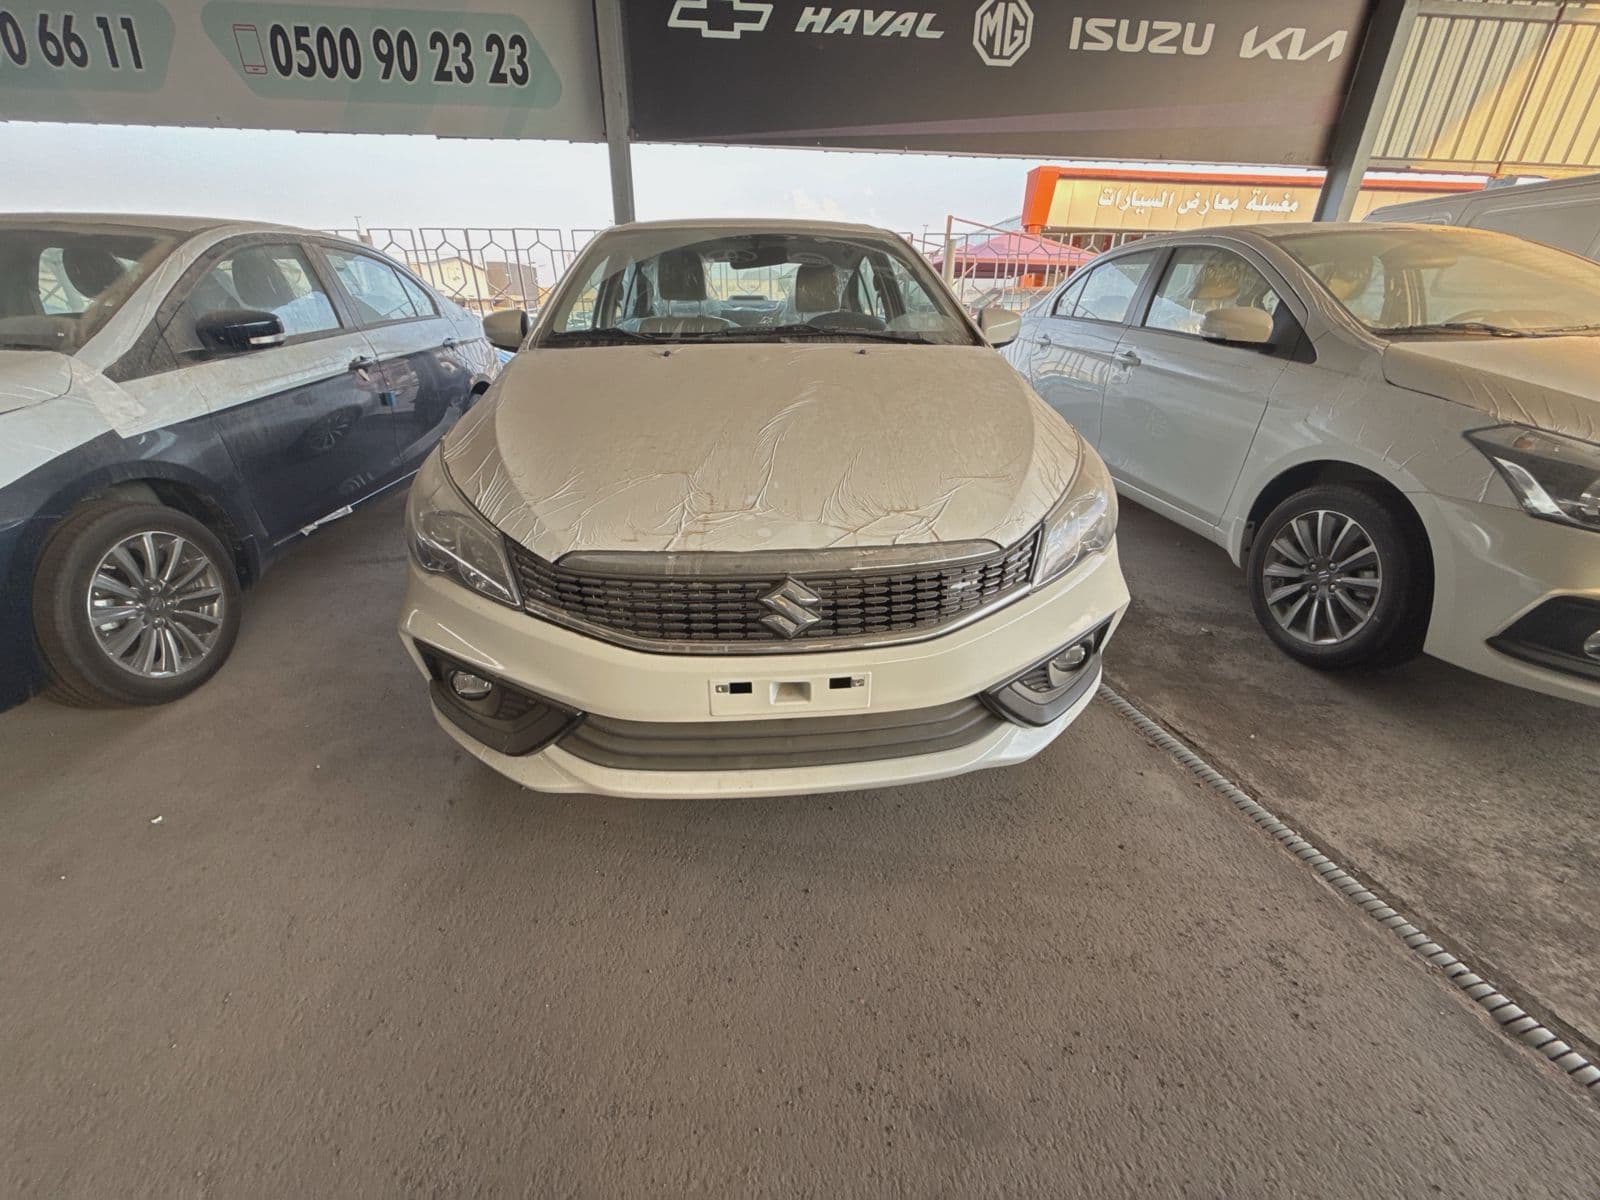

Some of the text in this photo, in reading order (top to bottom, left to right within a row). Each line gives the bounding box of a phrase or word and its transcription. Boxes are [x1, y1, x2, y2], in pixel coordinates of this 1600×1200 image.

[38, 13, 89, 68] 66
[95, 16, 143, 70] 11
[795, 6, 945, 39] HAVAL
[979, 1, 1027, 57] MG
[1068, 16, 1216, 55] ISUZU
[269, 23, 530, 86] 0500 90 23 23
[1098, 186, 1299, 215] مغسلة معارض السيارات
